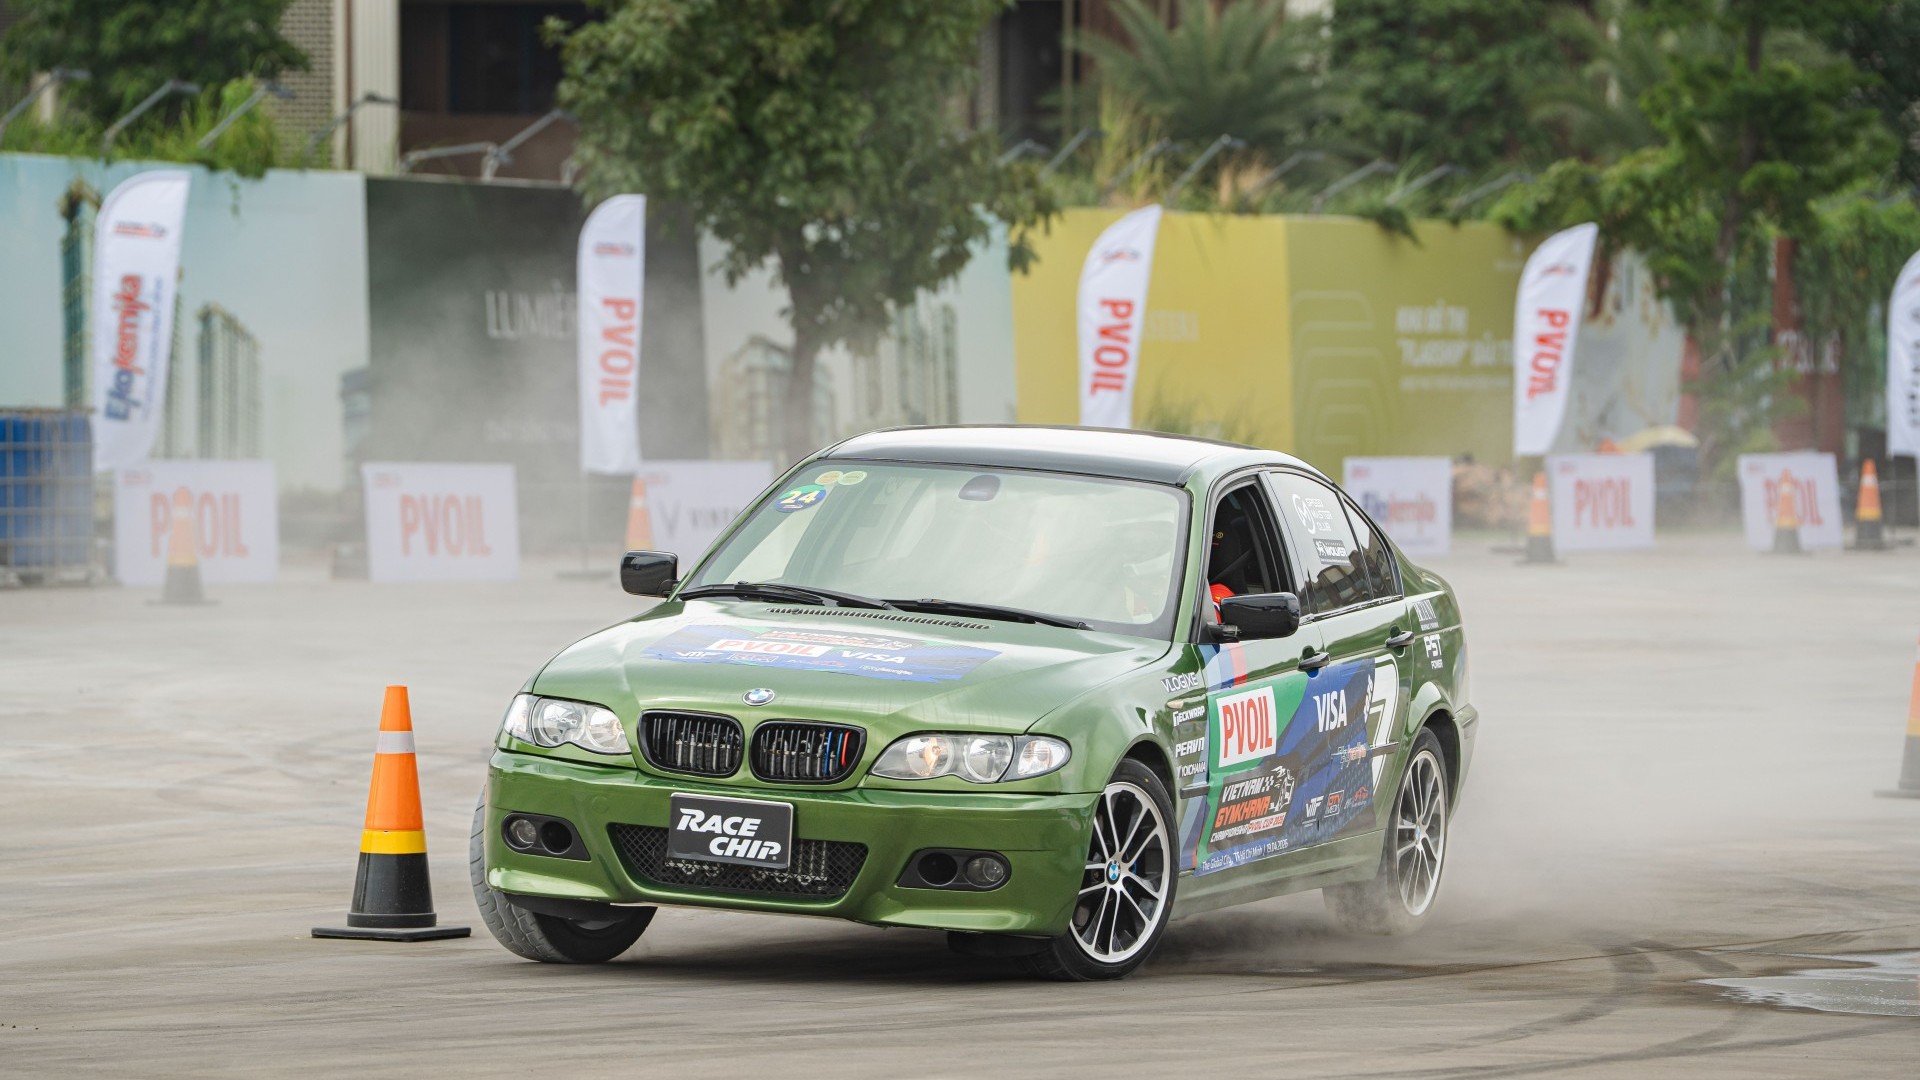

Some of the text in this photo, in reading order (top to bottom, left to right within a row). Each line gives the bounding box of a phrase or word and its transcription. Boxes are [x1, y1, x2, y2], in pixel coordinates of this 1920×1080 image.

[599, 297, 636, 407] PVOIL
[1089, 297, 1134, 397] PVOIL
[1526, 308, 1570, 400] PVOIL
[780, 489, 821, 504] 24
[1573, 478, 1634, 529] PVOIL
[1763, 477, 1824, 527] POIL
[151, 492, 249, 559] POIL
[400, 493, 492, 557] PVOIL
[714, 640, 817, 656] PVOIL
[841, 649, 906, 664] VISA
[1423, 633, 1442, 658] PST
[1222, 695, 1273, 759] PVOIL
[1312, 689, 1348, 733] VISA
[1214, 795, 1272, 829] GYMKHANA
[1222, 777, 1266, 803] VIETNAM
[677, 807, 762, 837] RACE
[1202, 860, 1210, 872] The
